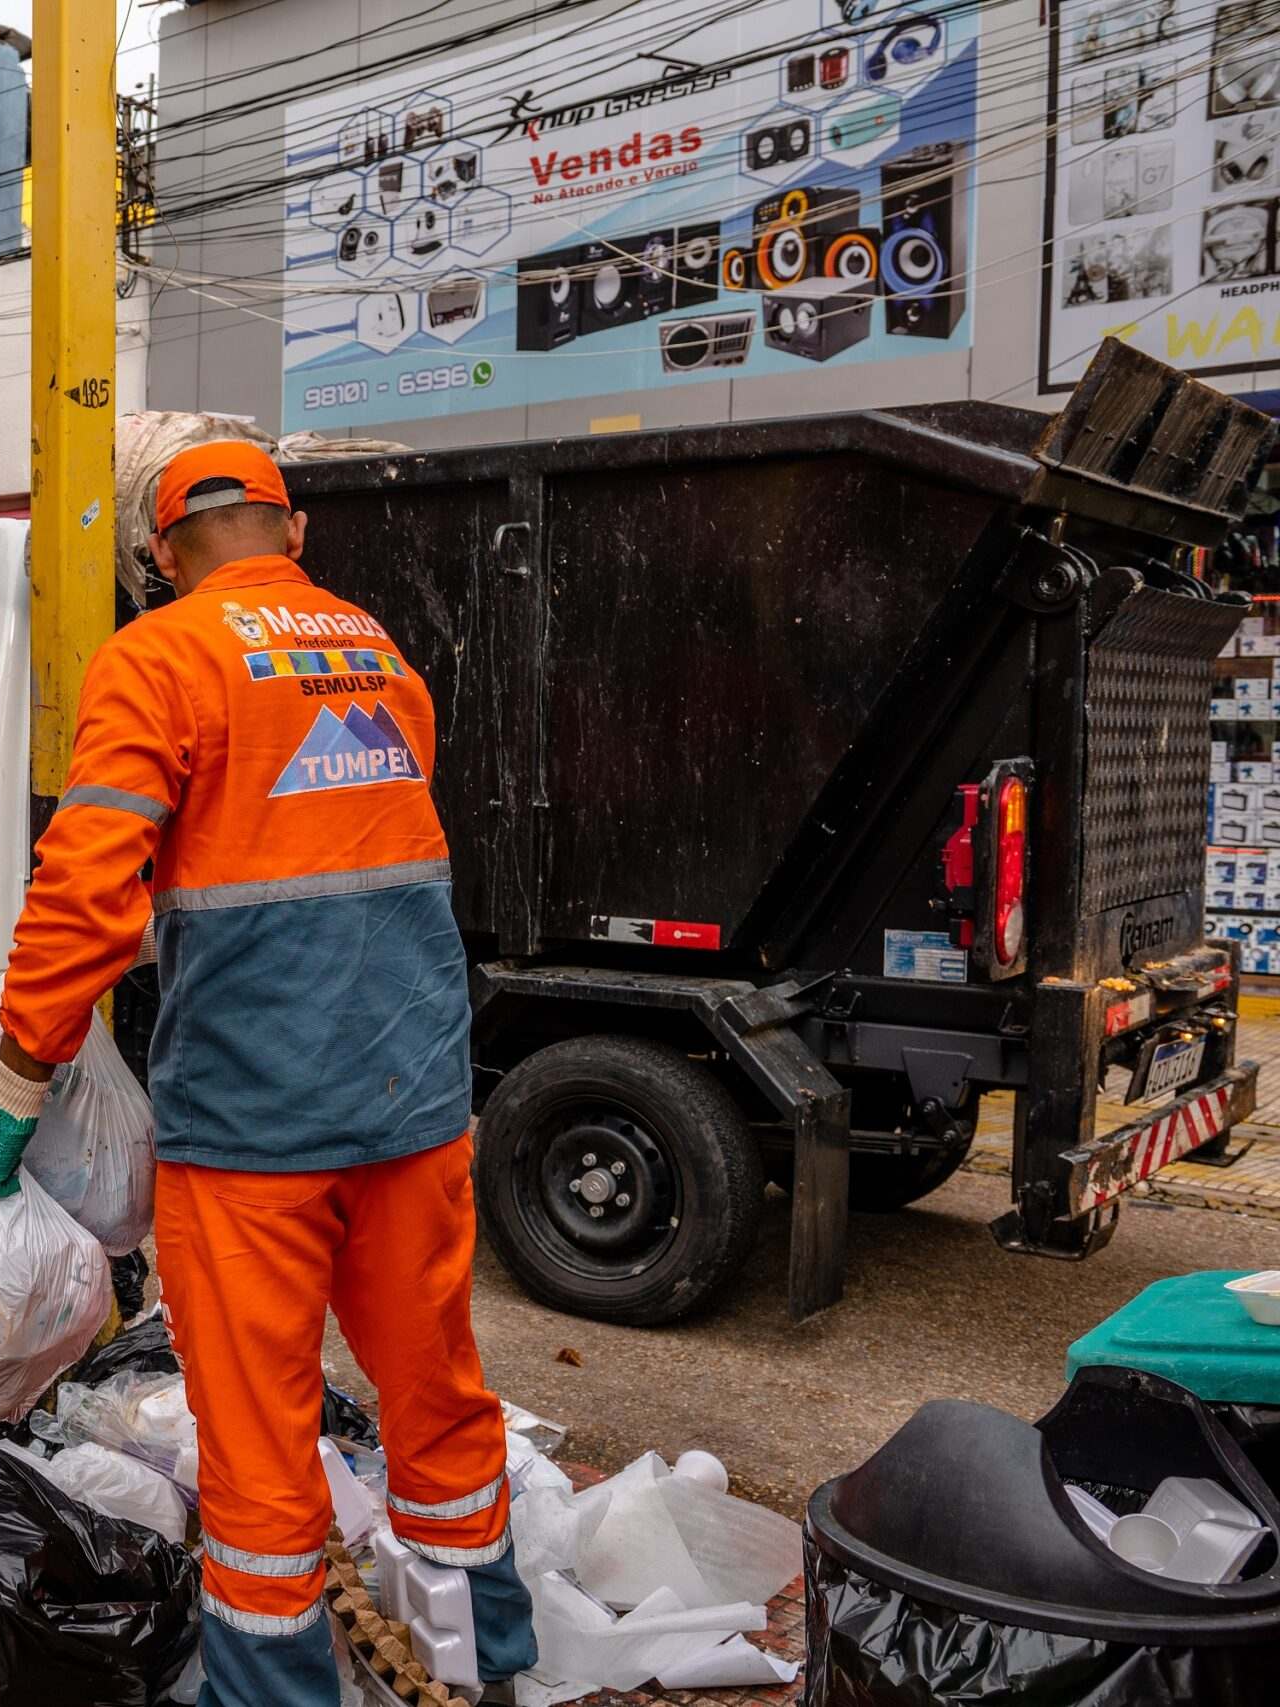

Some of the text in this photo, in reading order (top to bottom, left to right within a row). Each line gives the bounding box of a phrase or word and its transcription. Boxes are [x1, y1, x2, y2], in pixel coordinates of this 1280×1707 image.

[530, 127, 702, 186] Vendas
[533, 160, 698, 204] No Atacado e Varejo
[1142, 165, 1169, 185] G7
[1166, 306, 1280, 359] WA
[82, 378, 111, 409] 185
[304, 379, 369, 410] 98101
[398, 363, 468, 396] 6996
[258, 606, 388, 641] Manaus
[294, 637, 355, 648] Prefeitura
[300, 675, 387, 696] SEMULSP
[300, 747, 413, 784] TUMPEX
